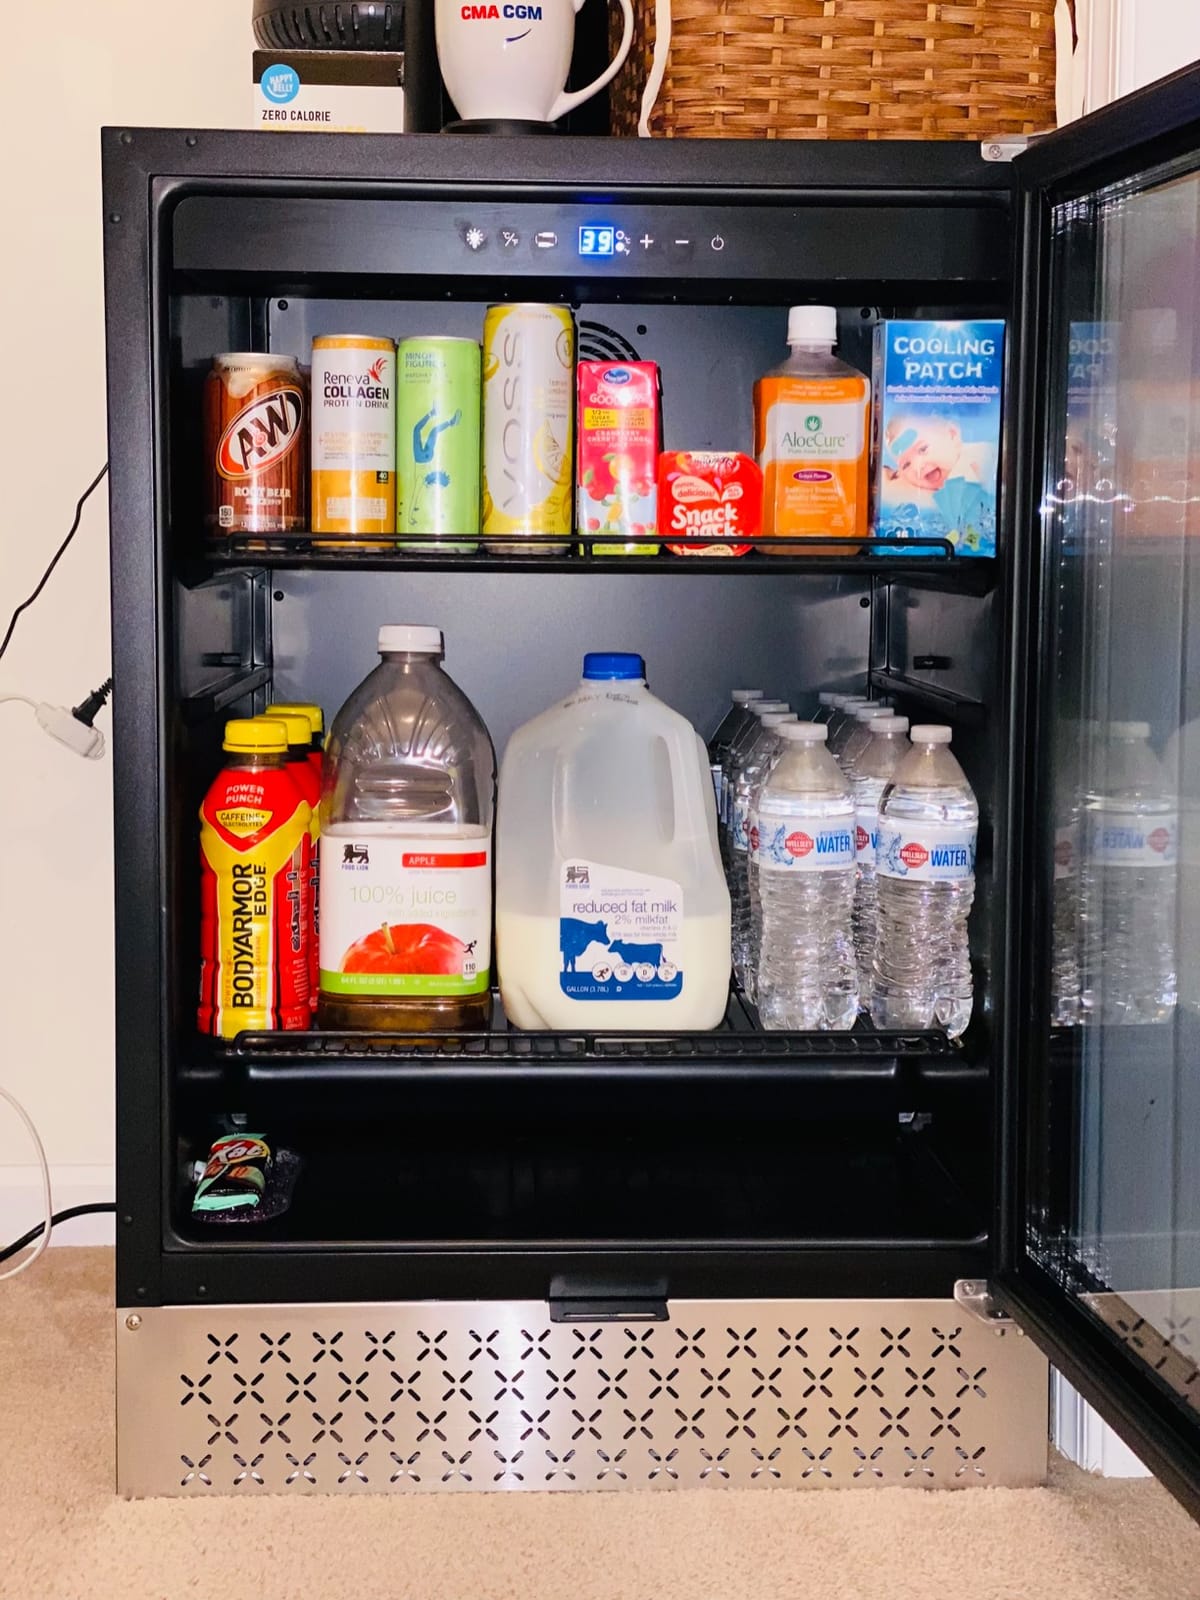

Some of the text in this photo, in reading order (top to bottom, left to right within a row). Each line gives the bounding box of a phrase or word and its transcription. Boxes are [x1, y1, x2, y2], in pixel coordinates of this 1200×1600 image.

[461, 4, 542, 21] CMA CGM
[262, 109, 332, 122] ZERO CALORIE
[582, 230, 612, 252] 39
[893, 336, 995, 356] COOLING
[323, 371, 370, 385] Reneva
[904, 361, 983, 381] PATCH
[323, 386, 390, 400] COLLAGEN
[323, 399, 390, 409] PROTIN DRINK
[780, 431, 847, 448] AloeCure
[671, 502, 739, 530] Snack
[225, 783, 265, 796] POWER
[225, 794, 263, 805] PUNCH
[816, 834, 850, 854] WATER
[408, 855, 437, 866] APPLE
[930, 849, 967, 867] WATER
[341, 863, 369, 872] FOOD LION
[253, 864, 267, 916] EDGE
[350, 884, 458, 909] 100% juice
[572, 899, 678, 914] reduced fat milk
[614, 914, 669, 925] 2% milkfat
[232, 863, 254, 1009] BODYARMOR
[566, 985, 589, 993] GALLON
